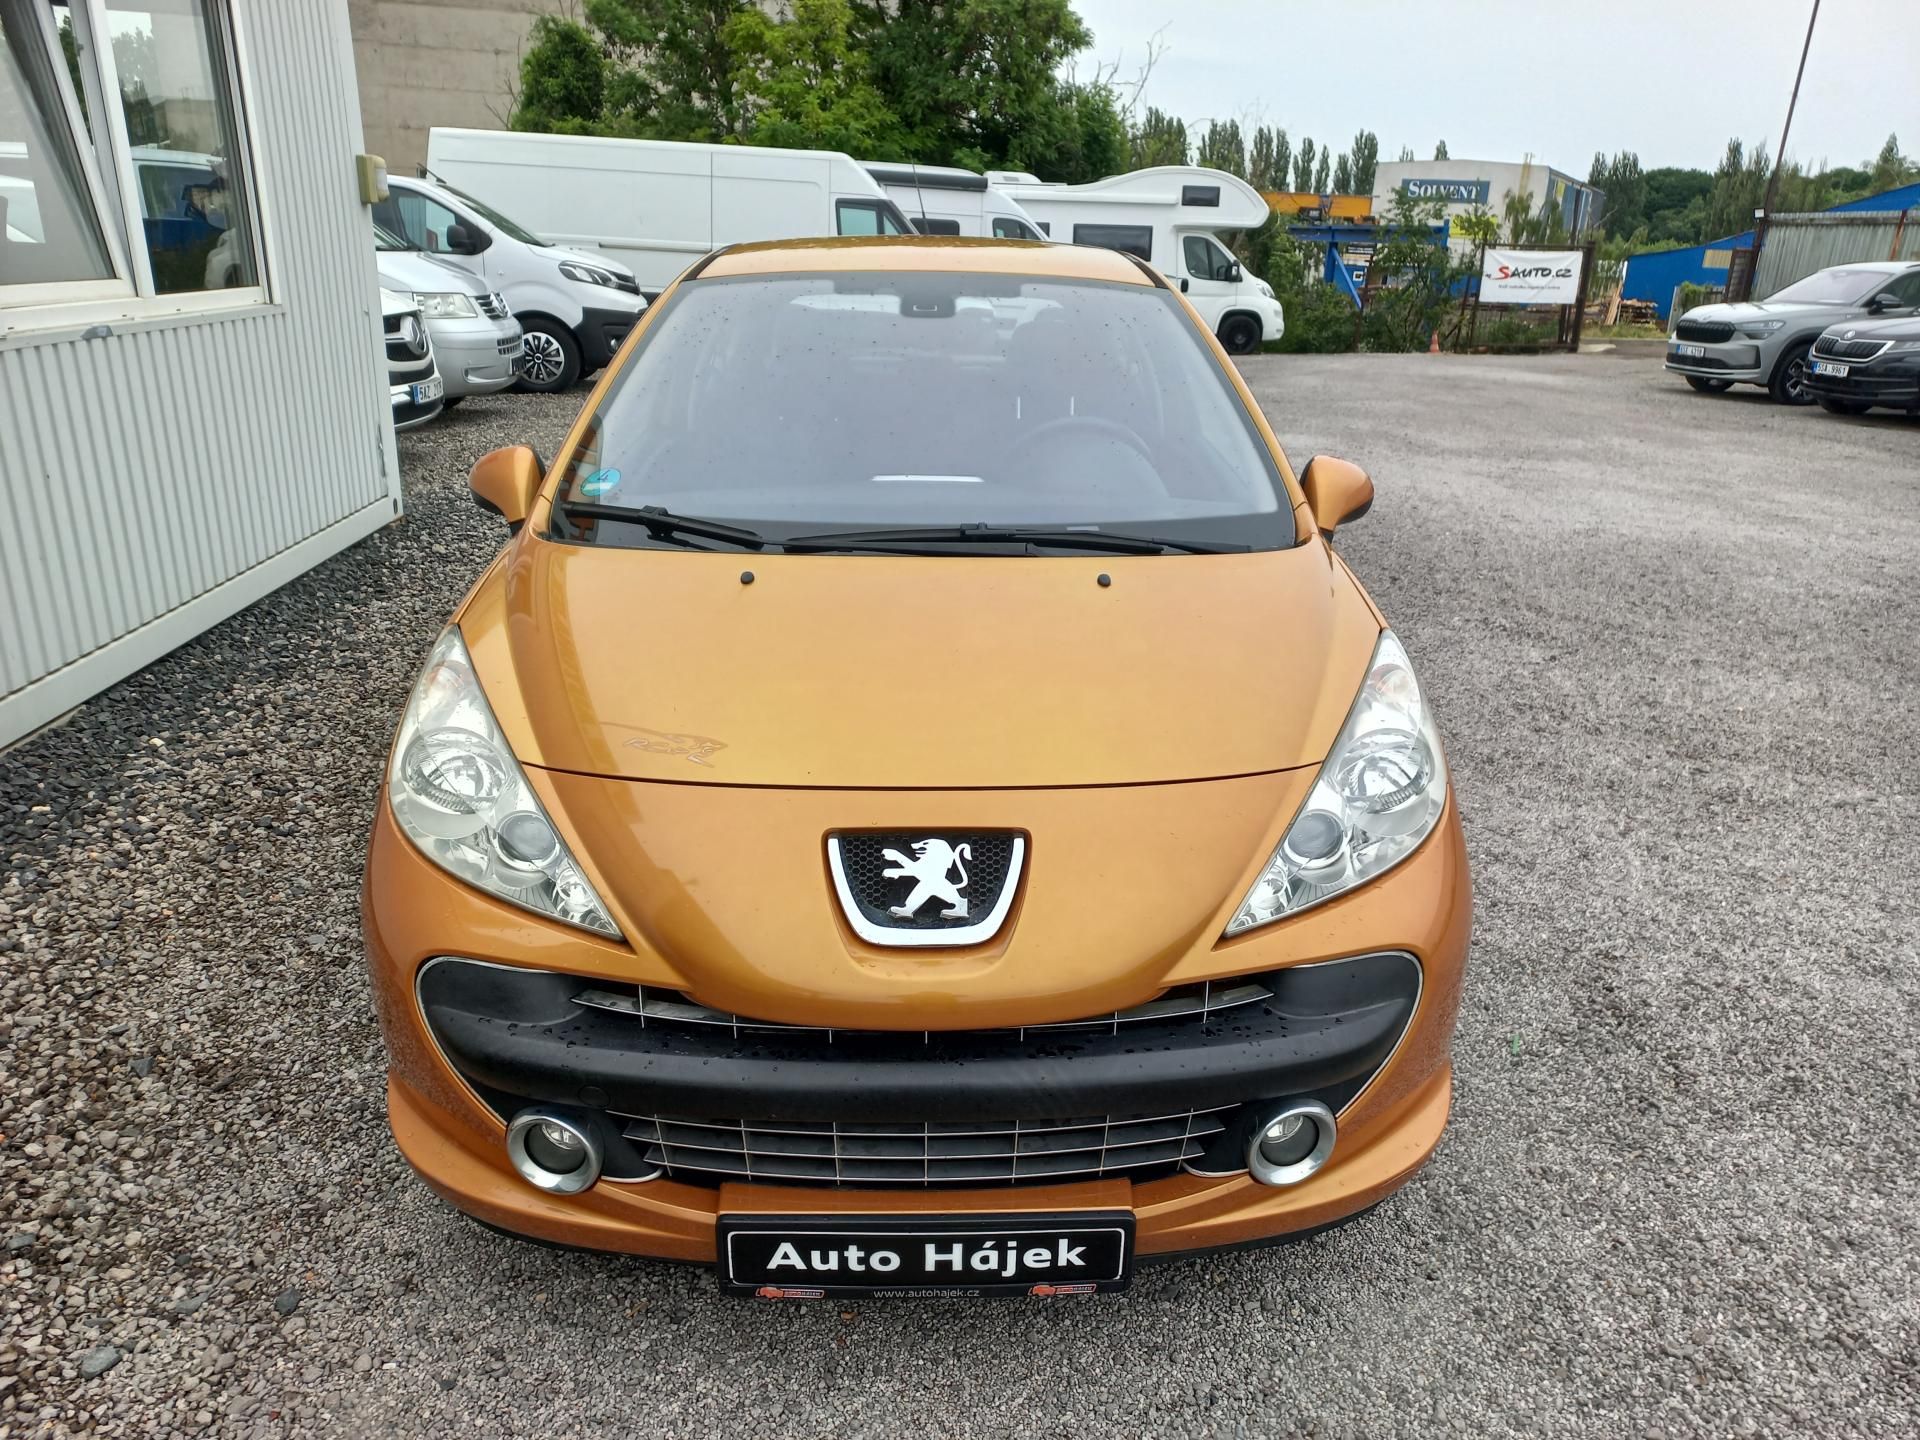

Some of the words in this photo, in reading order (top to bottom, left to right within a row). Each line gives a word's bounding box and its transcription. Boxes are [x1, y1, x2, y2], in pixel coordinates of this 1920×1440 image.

[1407, 180, 1480, 200] SOLVENT
[766, 1242, 901, 1272] Auto
[925, 1238, 1087, 1277] Hájek
[873, 1288, 980, 1299] www.autohajek.cz
